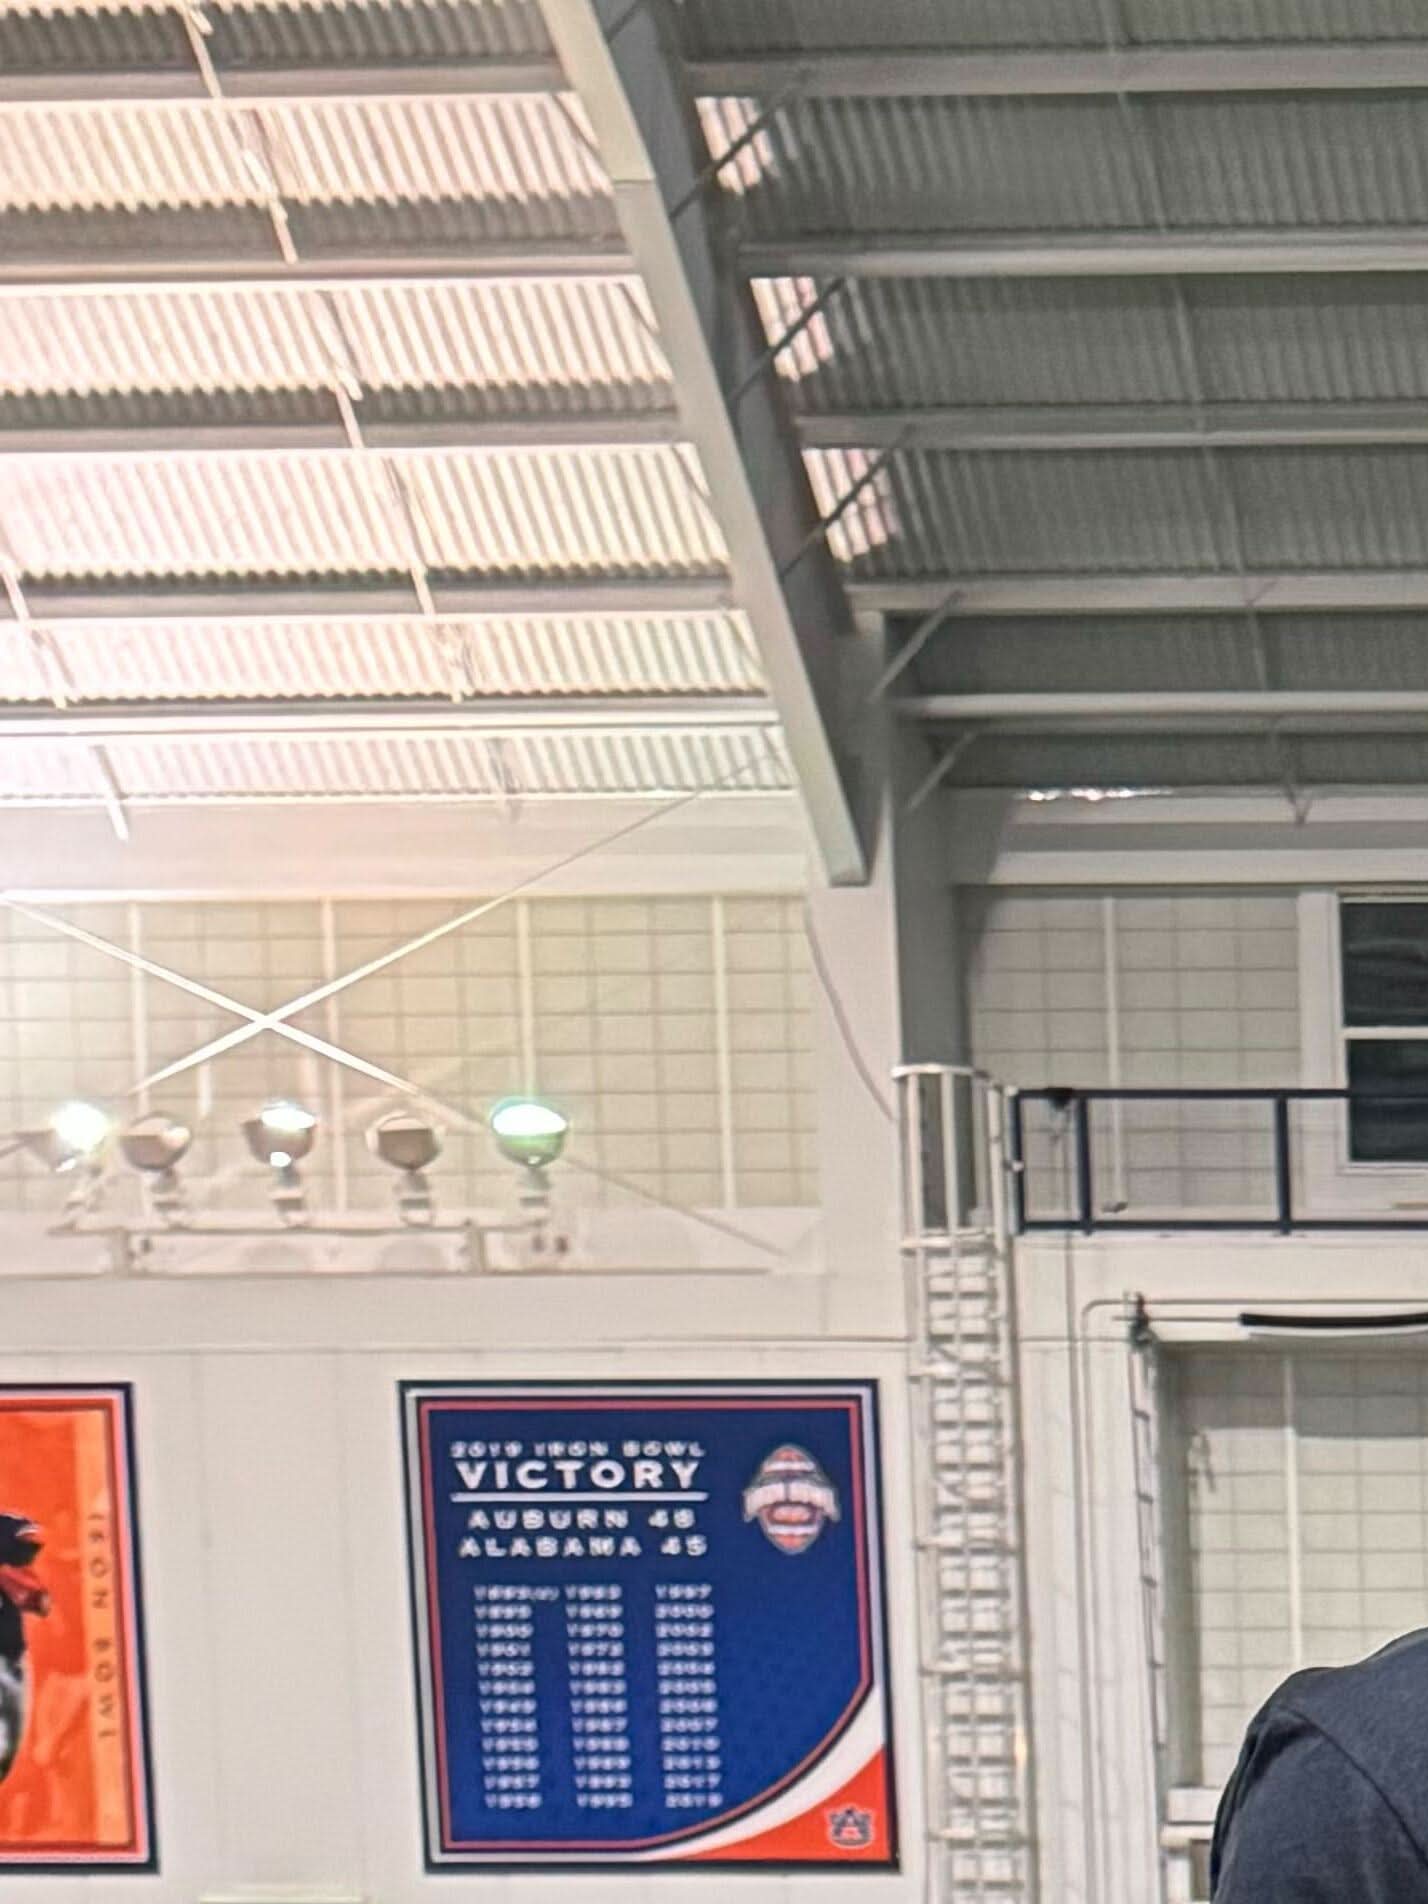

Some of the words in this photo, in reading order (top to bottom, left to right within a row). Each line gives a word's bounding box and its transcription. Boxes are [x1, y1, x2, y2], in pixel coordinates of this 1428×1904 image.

[455, 1459, 700, 1490] VICTORY
[467, 1508, 629, 1530] AUBURN
[458, 1535, 643, 1558] ALABAMA
[660, 1534, 709, 1558] 45
